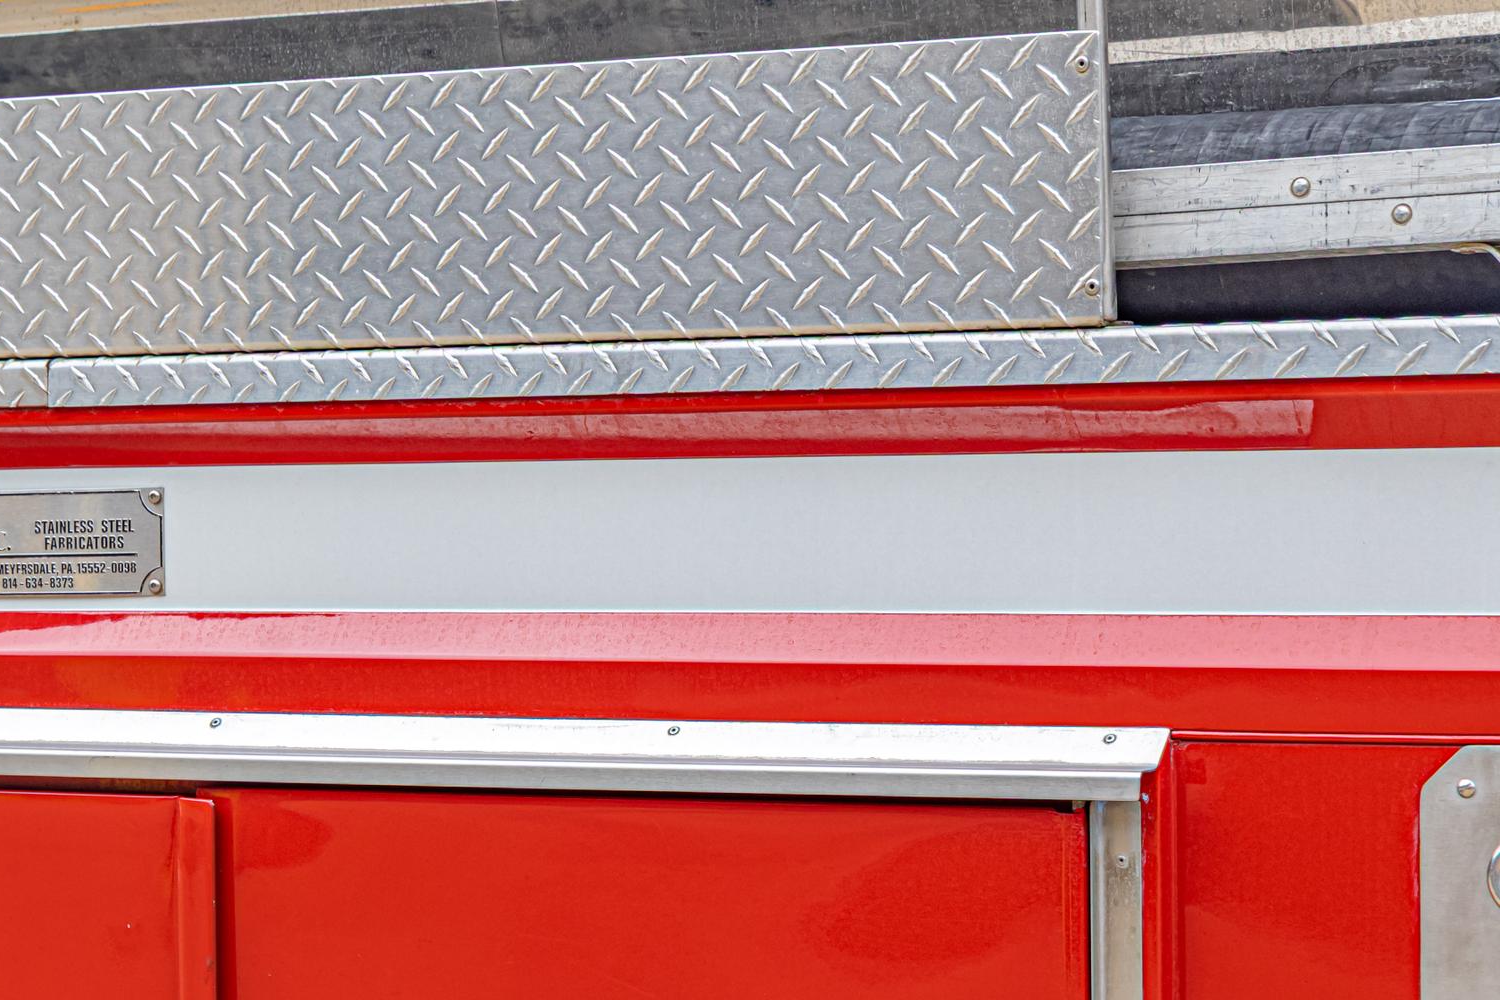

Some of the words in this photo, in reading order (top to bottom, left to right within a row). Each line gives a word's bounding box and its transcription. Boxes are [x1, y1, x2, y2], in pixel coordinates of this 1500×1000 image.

[34, 519, 94, 534] STAINLESS
[101, 518, 135, 533] STEEL
[77, 561, 137, 574] 15552-0098
